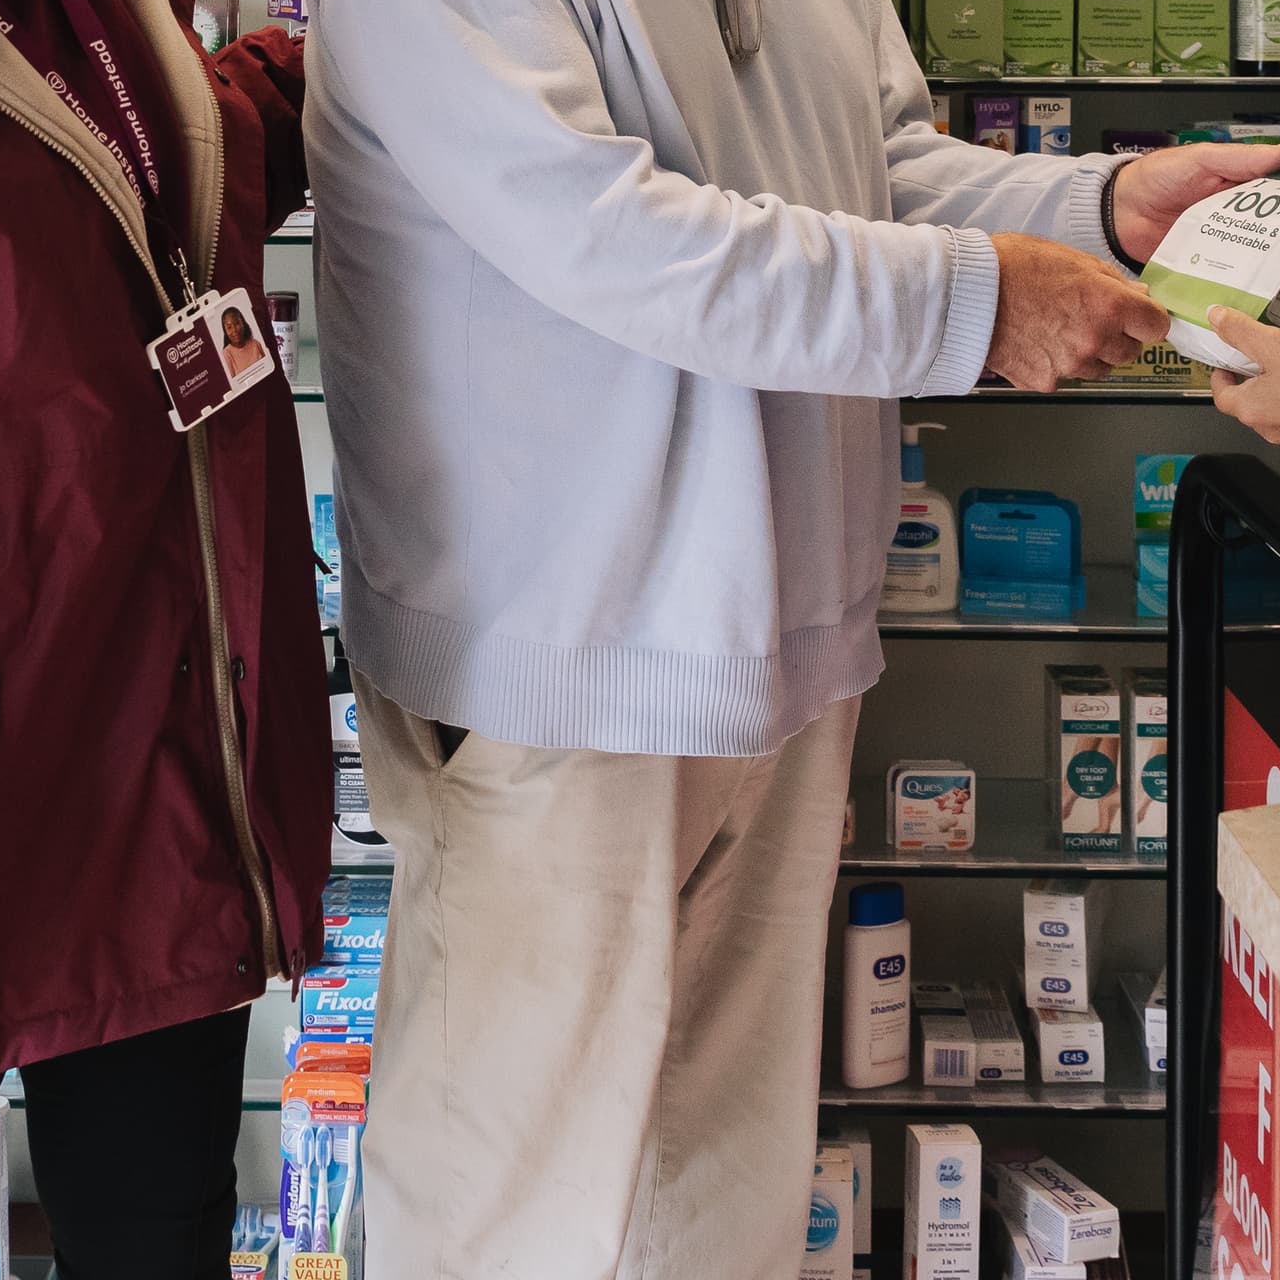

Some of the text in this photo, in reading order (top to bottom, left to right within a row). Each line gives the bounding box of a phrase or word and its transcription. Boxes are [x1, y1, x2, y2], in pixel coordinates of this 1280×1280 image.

[90, 39, 152, 167] Home Instead
[1034, 103, 1064, 112] HYLO-
[1208, 211, 1280, 238] Recyclable &
[1200, 223, 1271, 252] Compostable
[1153, 365, 1192, 376] Cream
[906, 780, 944, 795] Quies
[1043, 923, 1066, 936] E45
[877, 958, 903, 977] E45
[1045, 979, 1067, 993] E45
[870, 1001, 907, 1015] shampoo
[1062, 1051, 1085, 1064] E45
[287, 1169, 301, 1228] Wisdom
[1223, 1142, 1270, 1273] BLOOD
[928, 1221, 970, 1233] Hydromol
[1070, 1225, 1113, 1242] Zerobase
[295, 1257, 344, 1270] GREAT
[295, 1269, 342, 1280] VALUE
